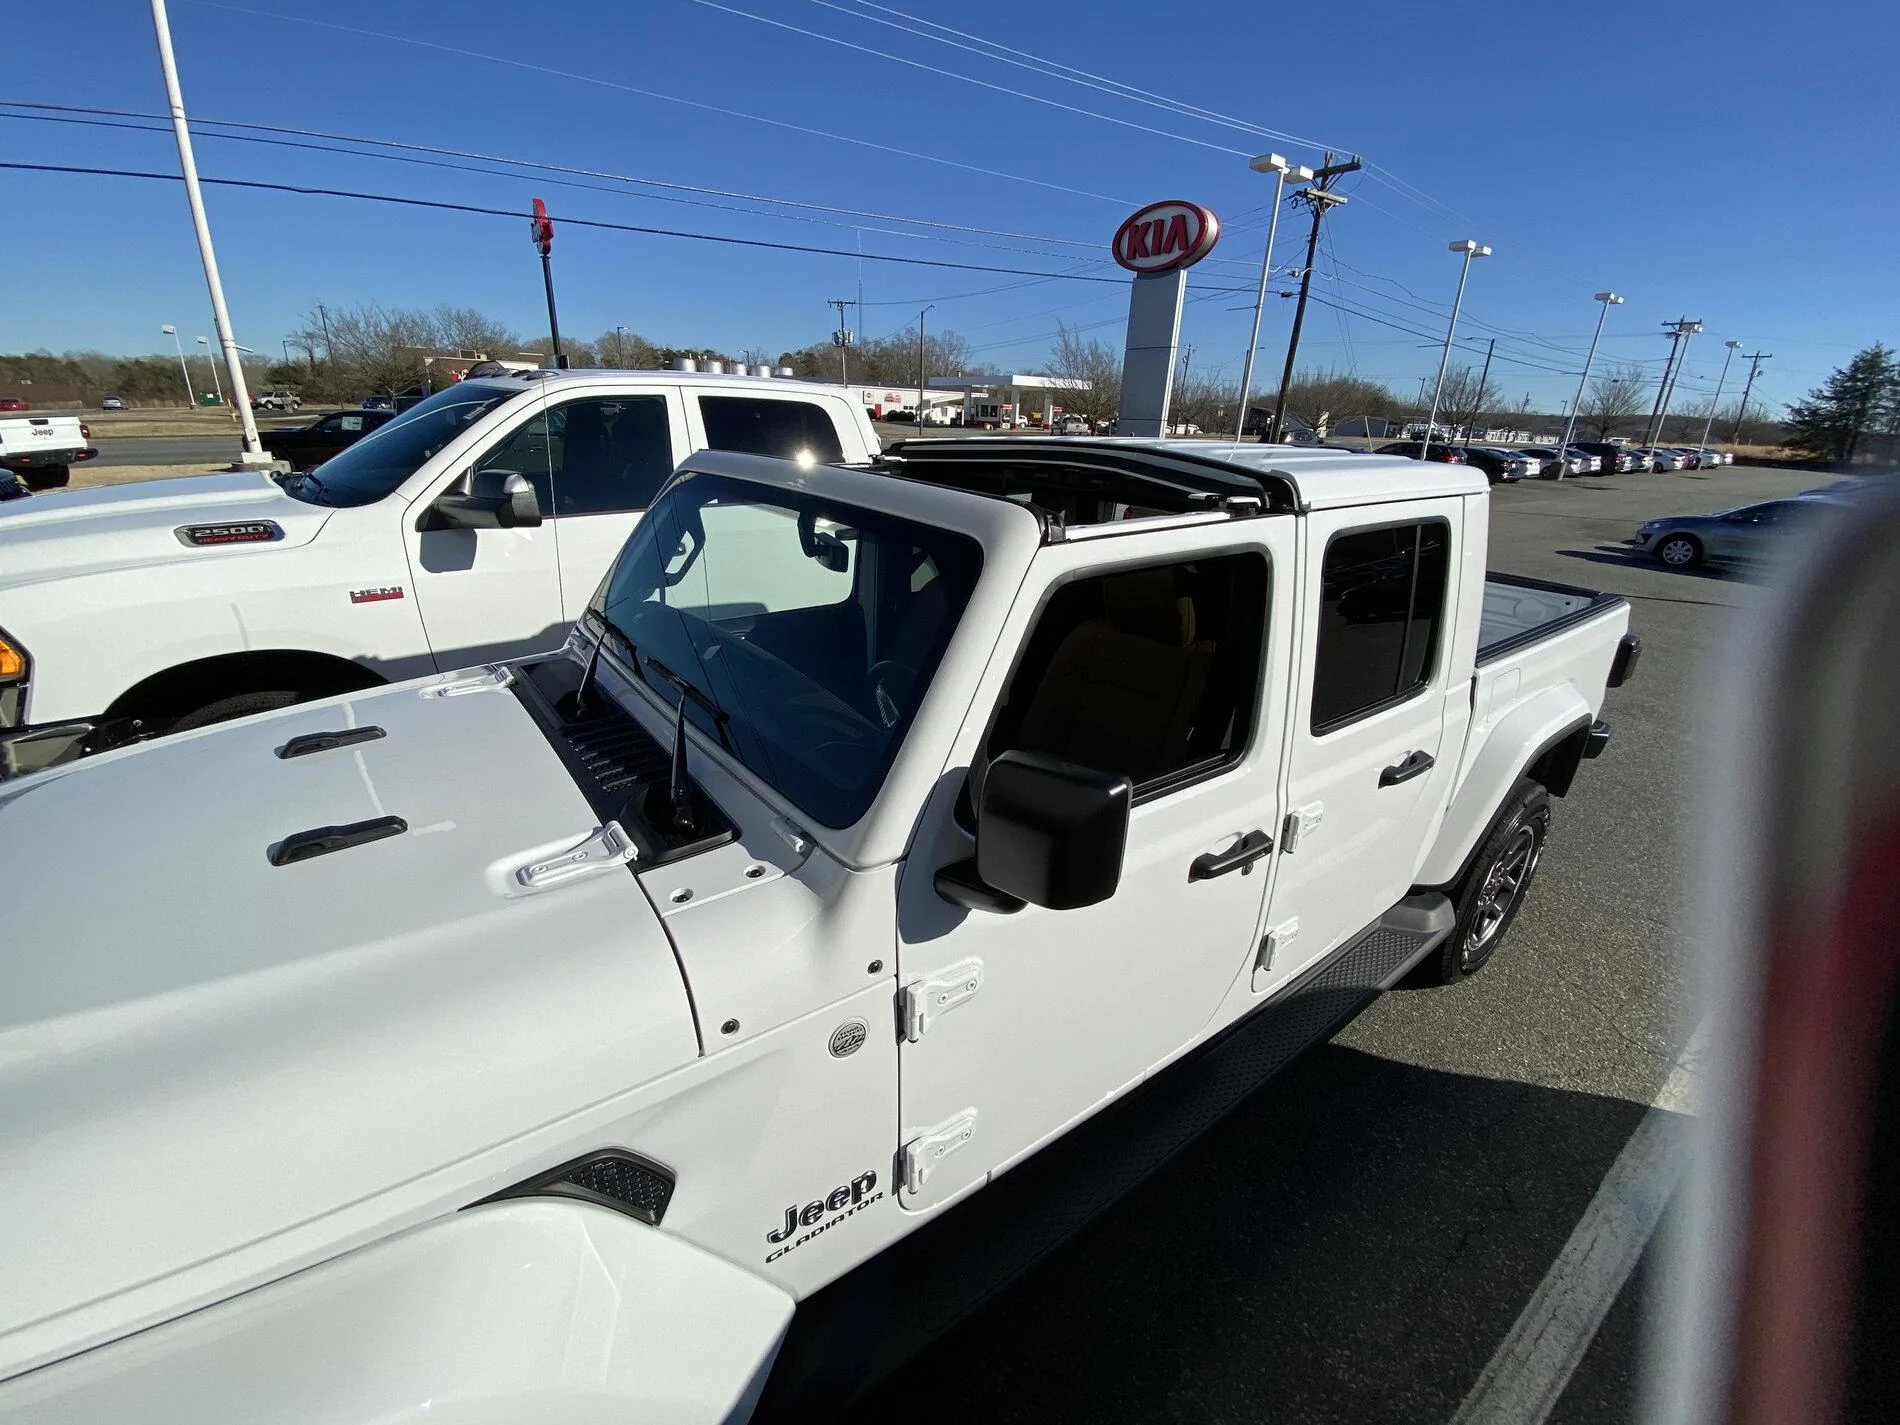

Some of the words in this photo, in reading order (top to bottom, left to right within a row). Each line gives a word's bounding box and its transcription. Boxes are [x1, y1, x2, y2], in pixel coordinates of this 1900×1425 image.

[1126, 214, 1189, 260] KIA
[32, 428, 53, 436] Jeep
[195, 525, 264, 537] 2500
[349, 586, 403, 599] HEMI
[766, 1170, 877, 1243] Jeep
[766, 1192, 883, 1263] GLADIATOR
